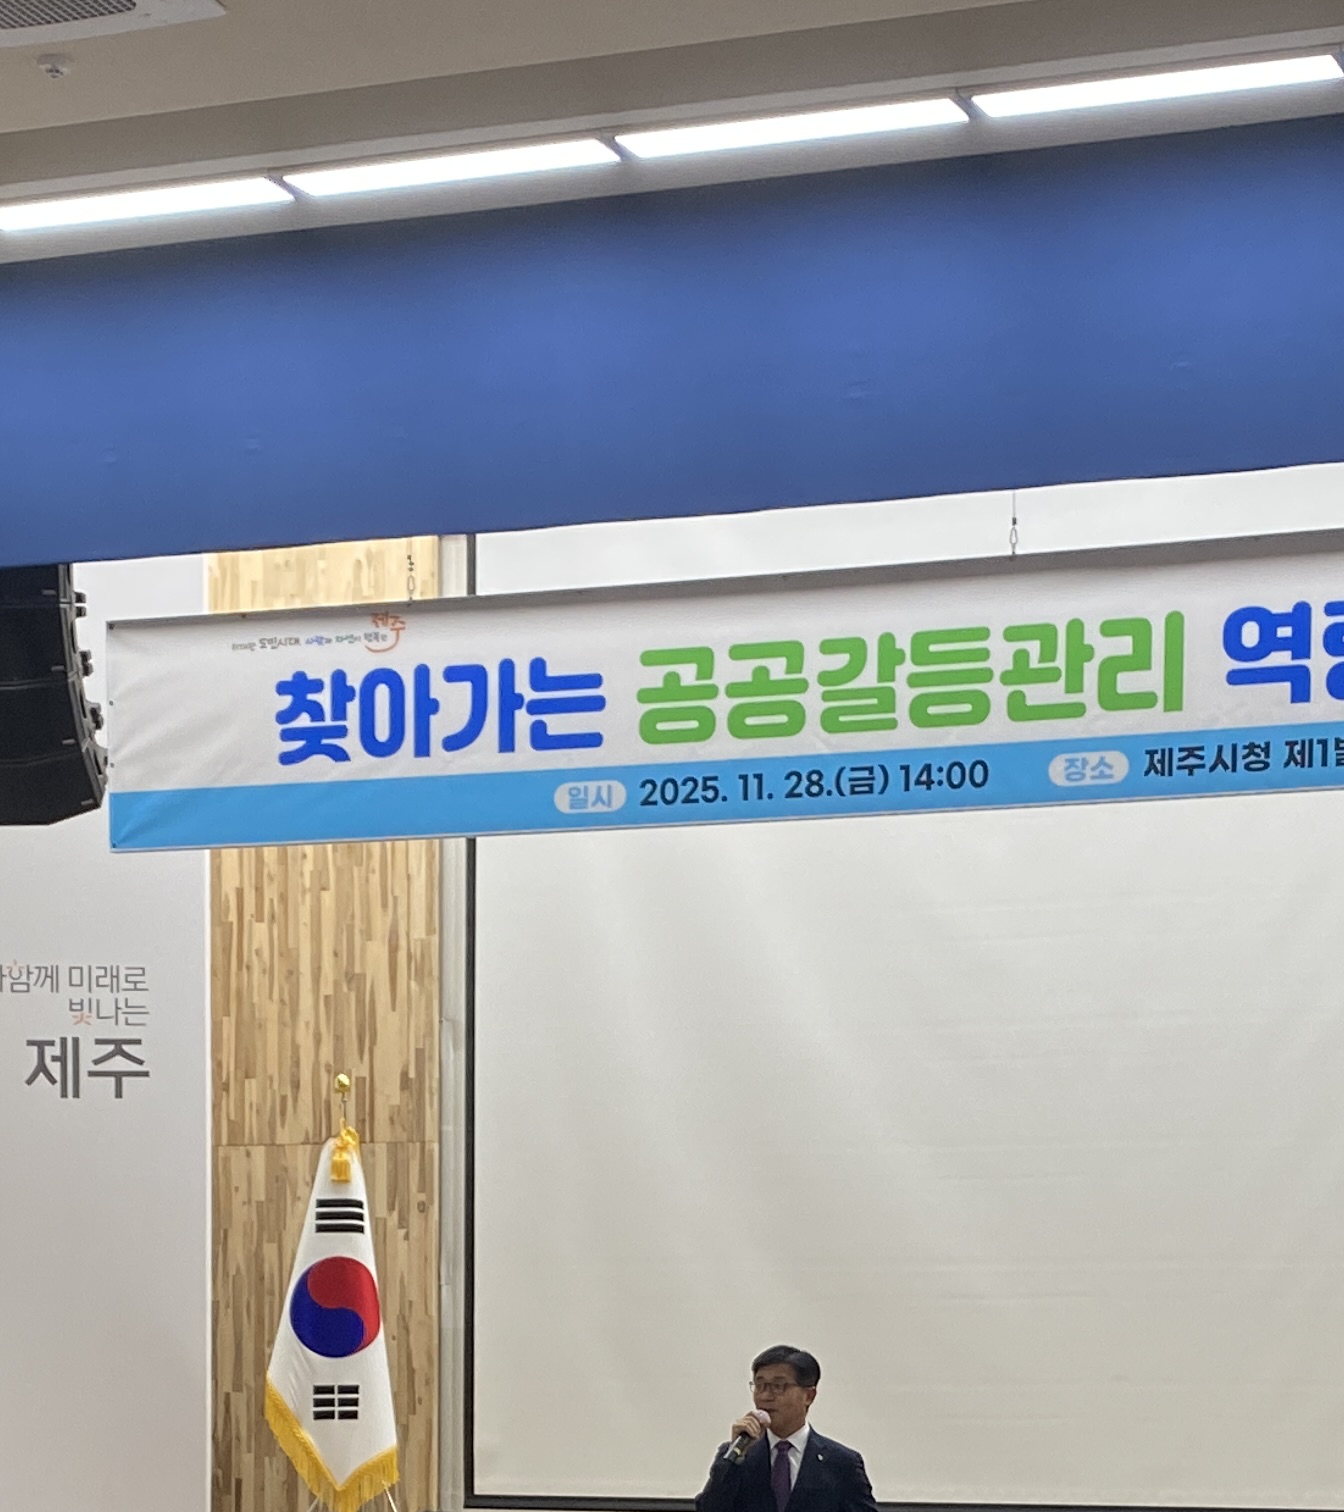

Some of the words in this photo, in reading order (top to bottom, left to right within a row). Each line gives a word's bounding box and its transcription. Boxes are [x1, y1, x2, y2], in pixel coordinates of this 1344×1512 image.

[275, 657, 606, 766] 찾아가는
[637, 610, 1184, 745] 공공갈등관리
[567, 784, 613, 810] 일시
[639, 774, 729, 807] 2025.
[739, 772, 773, 802] 11.
[784, 764, 890, 800] 28.(금)
[899, 758, 990, 794] 14:00
[1062, 756, 1116, 782] 장소
[1143, 740, 1272, 778] 제주시청
[67, 964, 150, 993] 미래로
[68, 997, 151, 1027] 빛나는
[24, 1036, 151, 1099] 제주
